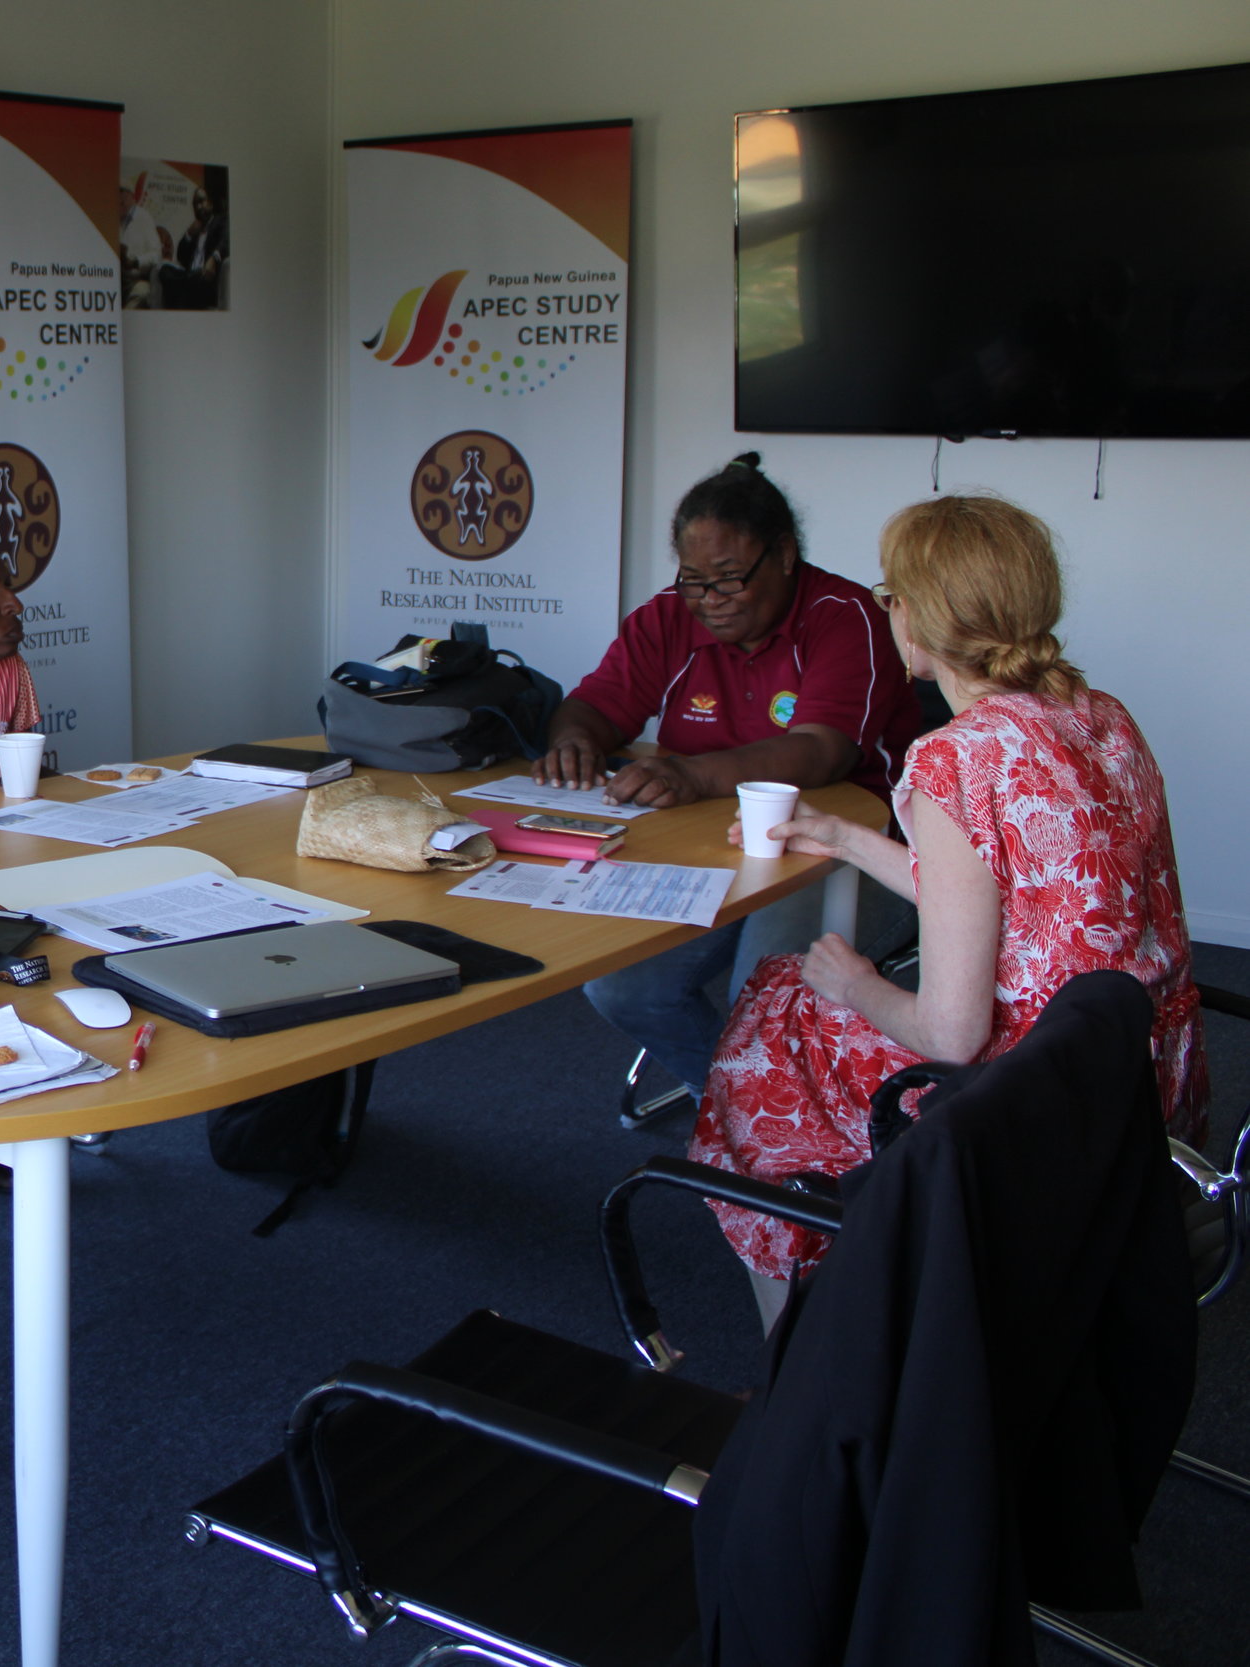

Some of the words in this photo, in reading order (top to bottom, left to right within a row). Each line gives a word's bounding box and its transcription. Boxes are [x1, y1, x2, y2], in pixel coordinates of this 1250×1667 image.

[11, 262, 48, 278] Papua
[51, 263, 76, 277] New
[78, 264, 114, 278] Guinea
[488, 274, 530, 288] Papua
[534, 272, 563, 285] New
[567, 270, 616, 283] Guinea
[54, 289, 118, 313] STUDY
[463, 296, 528, 318] APEC
[536, 293, 620, 315] STUDY
[40, 322, 119, 345] CENTRE
[518, 323, 619, 346] CENTRE
[406, 567, 443, 586] THE
[449, 569, 536, 590] NATIONAL
[21, 602, 66, 623] IONAL
[381, 590, 467, 610] RESEARCH
[475, 593, 564, 615] INSTITUTE
[413, 616, 448, 626] PAPUA
[18, 626, 91, 651] NSTITUTE
[28, 656, 57, 669] INEA
[33, 703, 78, 735] uire
[10, 964, 25, 974] THE
